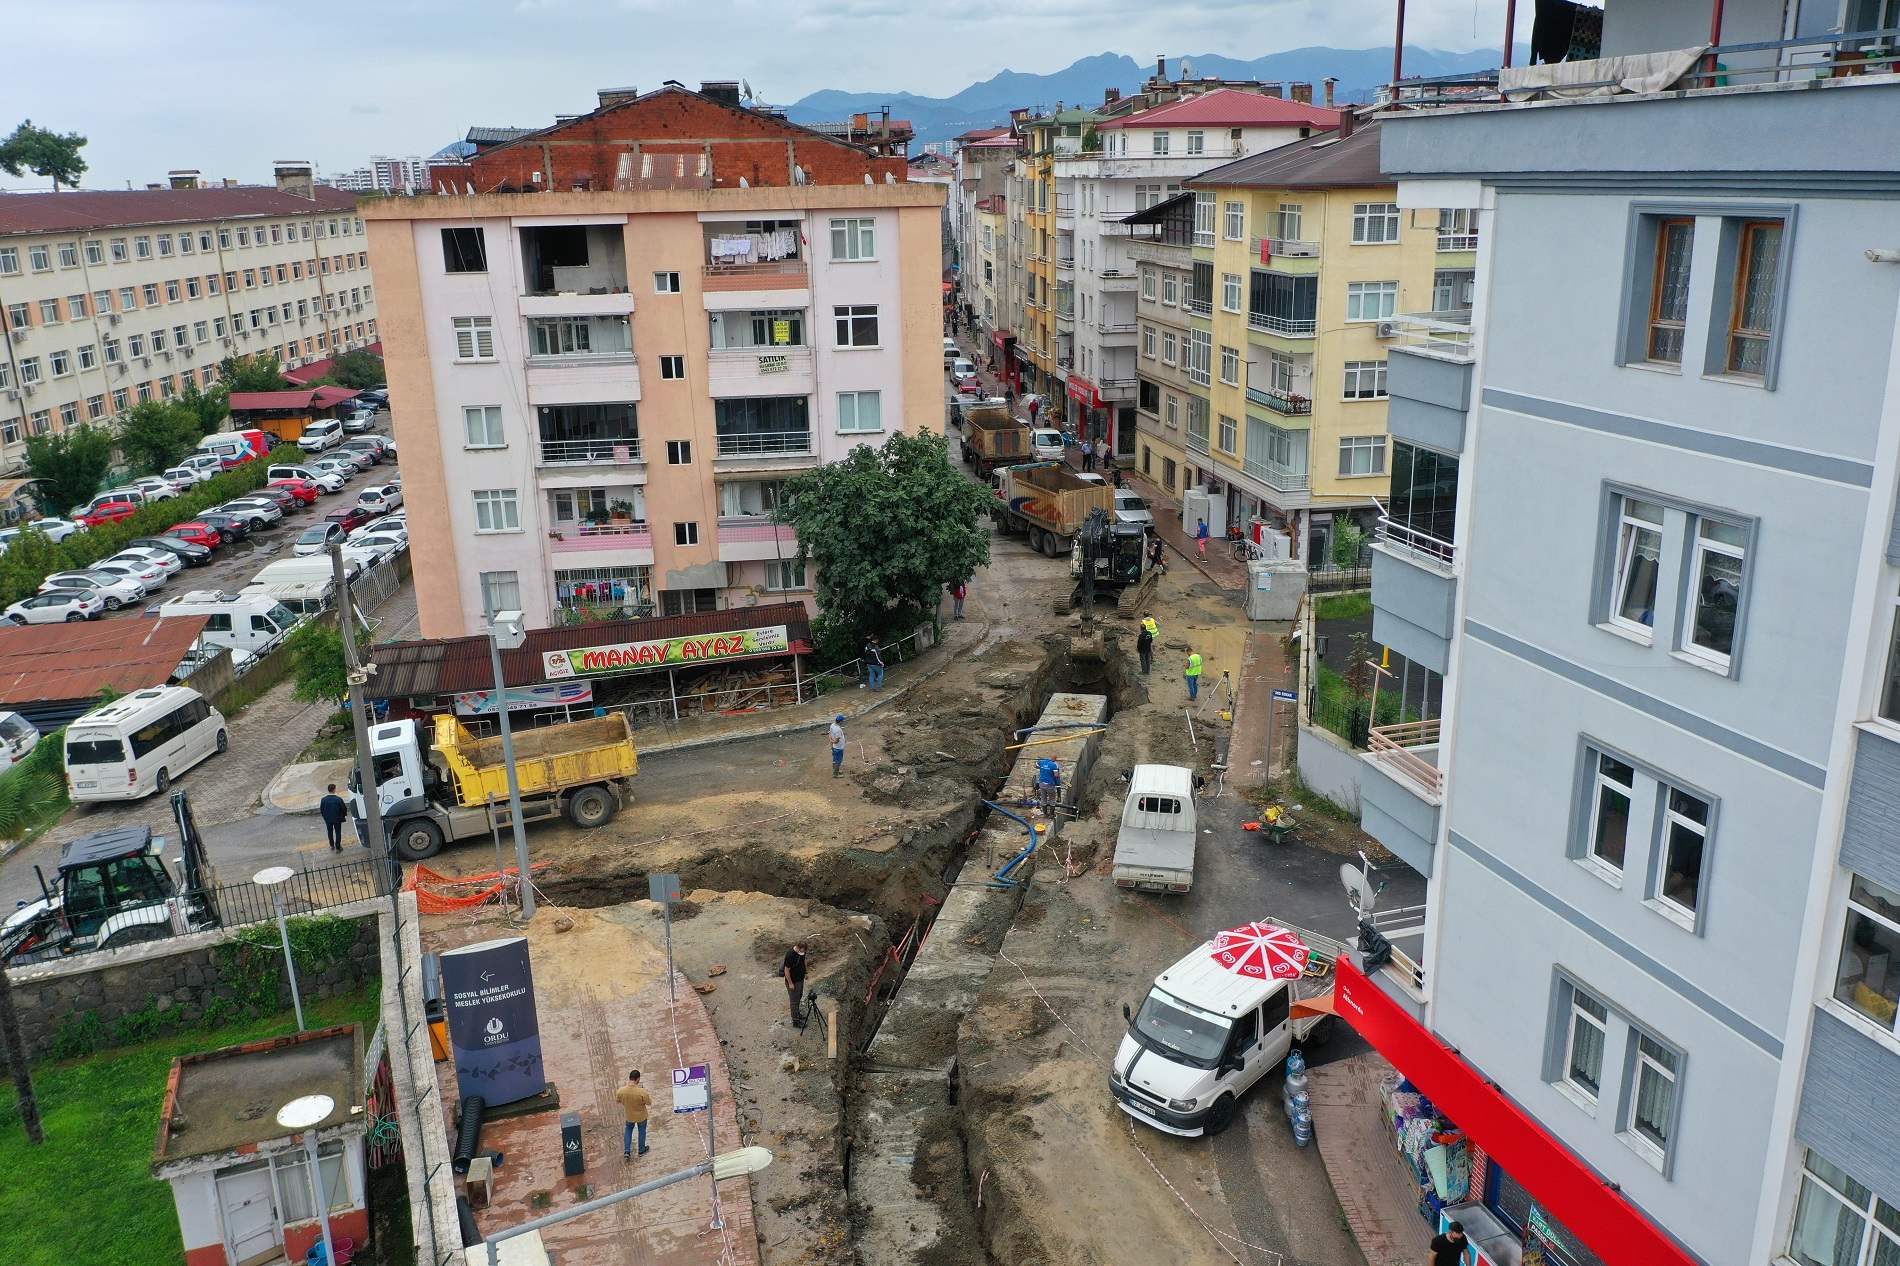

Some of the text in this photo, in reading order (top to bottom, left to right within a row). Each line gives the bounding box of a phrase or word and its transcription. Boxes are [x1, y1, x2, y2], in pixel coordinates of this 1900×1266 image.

[759, 356, 785, 364] SATILIK
[583, 635, 745, 670] MANAV AYAZ
[454, 984, 509, 999] SOSYAL BİLİMLER
[455, 987, 526, 1008] MESLEK YÜKSEKOKULU
[483, 1031, 509, 1043] ORDU
